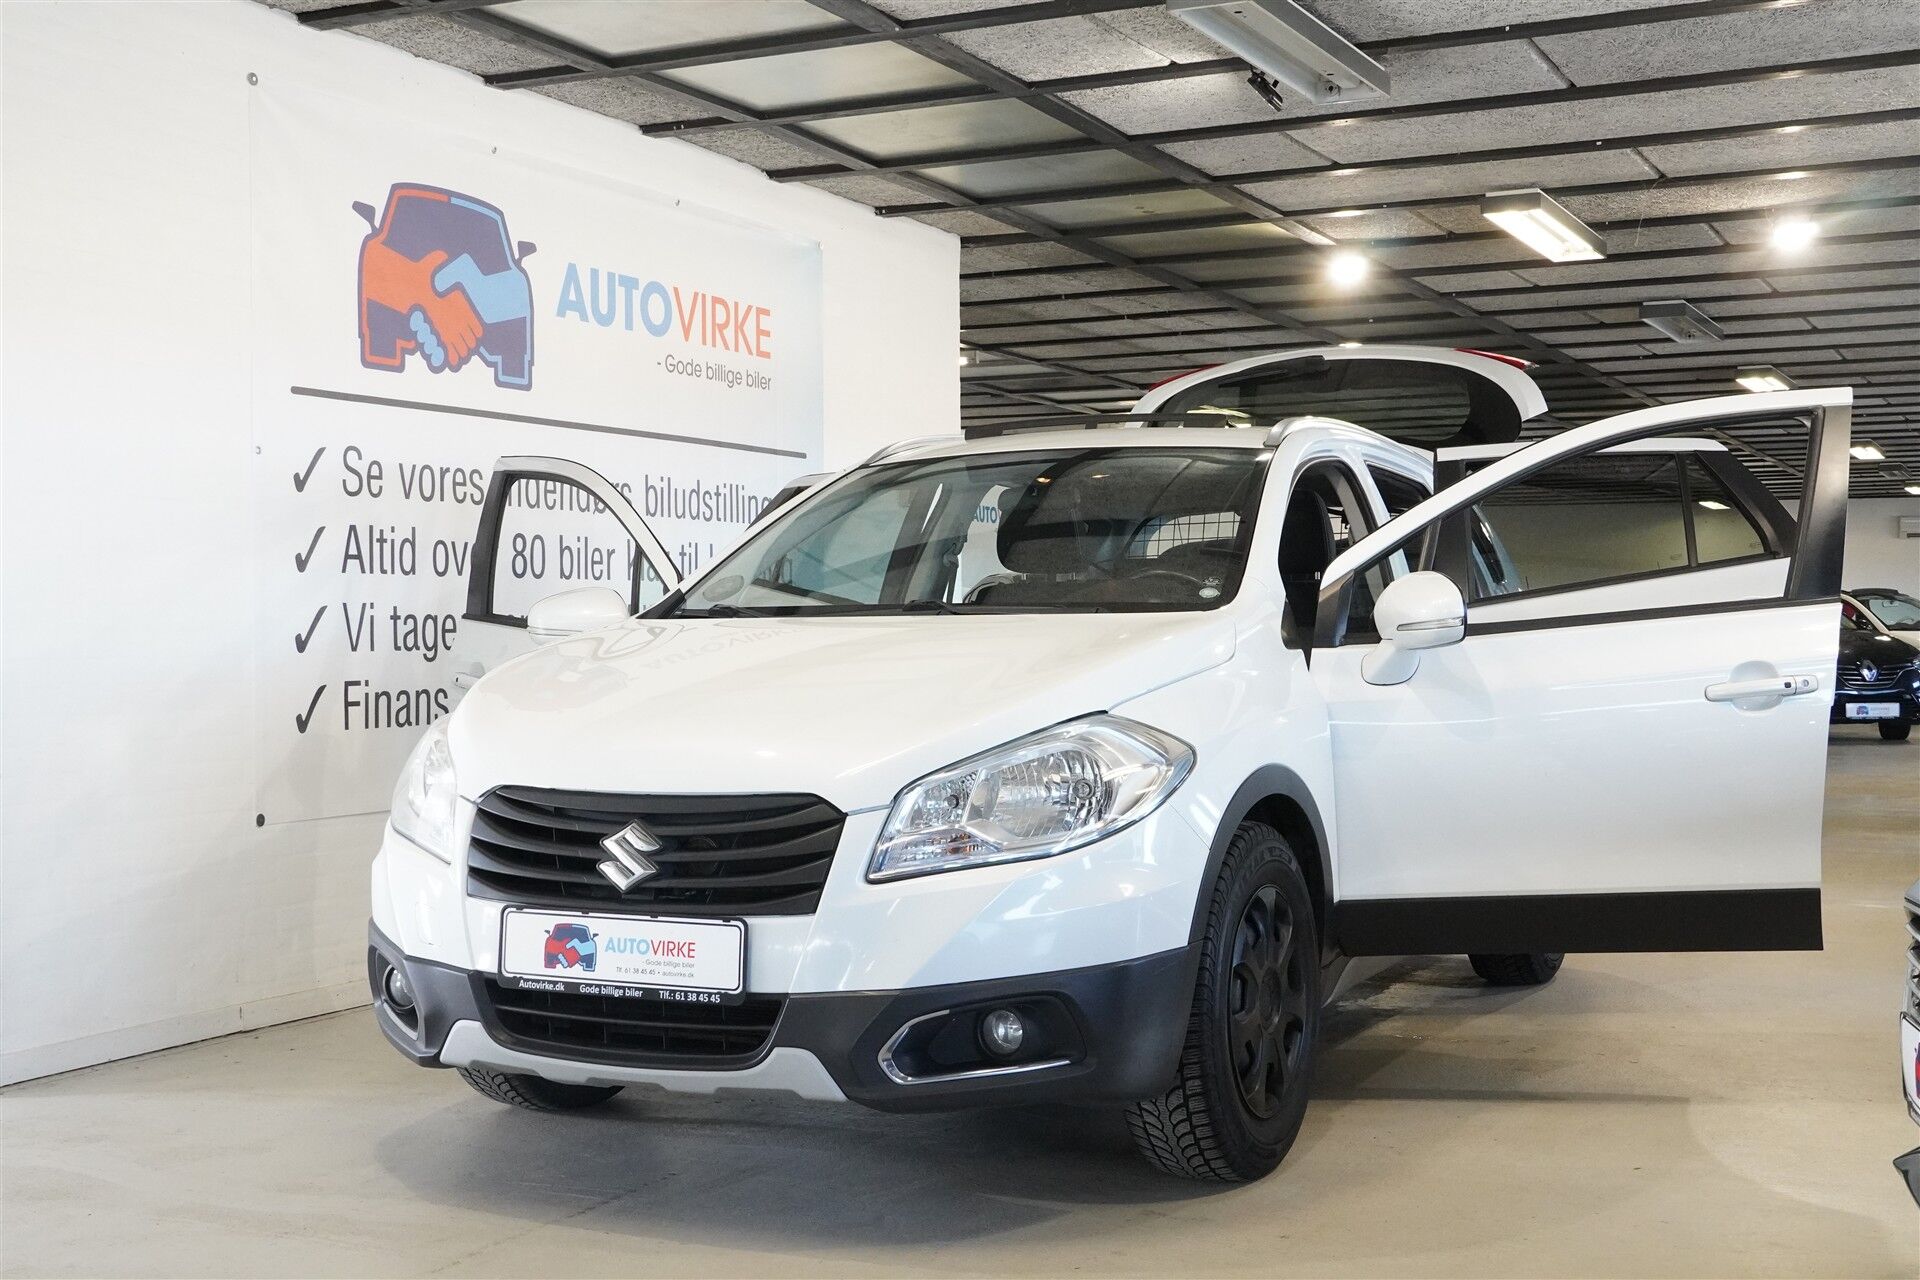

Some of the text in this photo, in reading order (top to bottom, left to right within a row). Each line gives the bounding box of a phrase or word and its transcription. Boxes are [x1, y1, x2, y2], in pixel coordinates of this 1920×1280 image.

[556, 262, 771, 360] AUTOVIRKE
[664, 354, 702, 378] Gode
[705, 361, 743, 388] billige
[746, 369, 771, 391] biler
[342, 445, 383, 498] Se
[398, 462, 485, 506] vores
[341, 524, 417, 576] Altid
[432, 538, 469, 577] ov
[511, 532, 547, 580] 80
[559, 534, 615, 581] biler
[342, 602, 375, 652] Vi
[604, 937, 696, 959] AUTOVIRKE
[645, 959, 662, 967] Gode
[663, 960, 681, 969] billige
[640, 968, 648, 976] 45
[519, 979, 721, 1004] Autovirke.dk Gode billige biler Tlf.: 61 38 45 45
